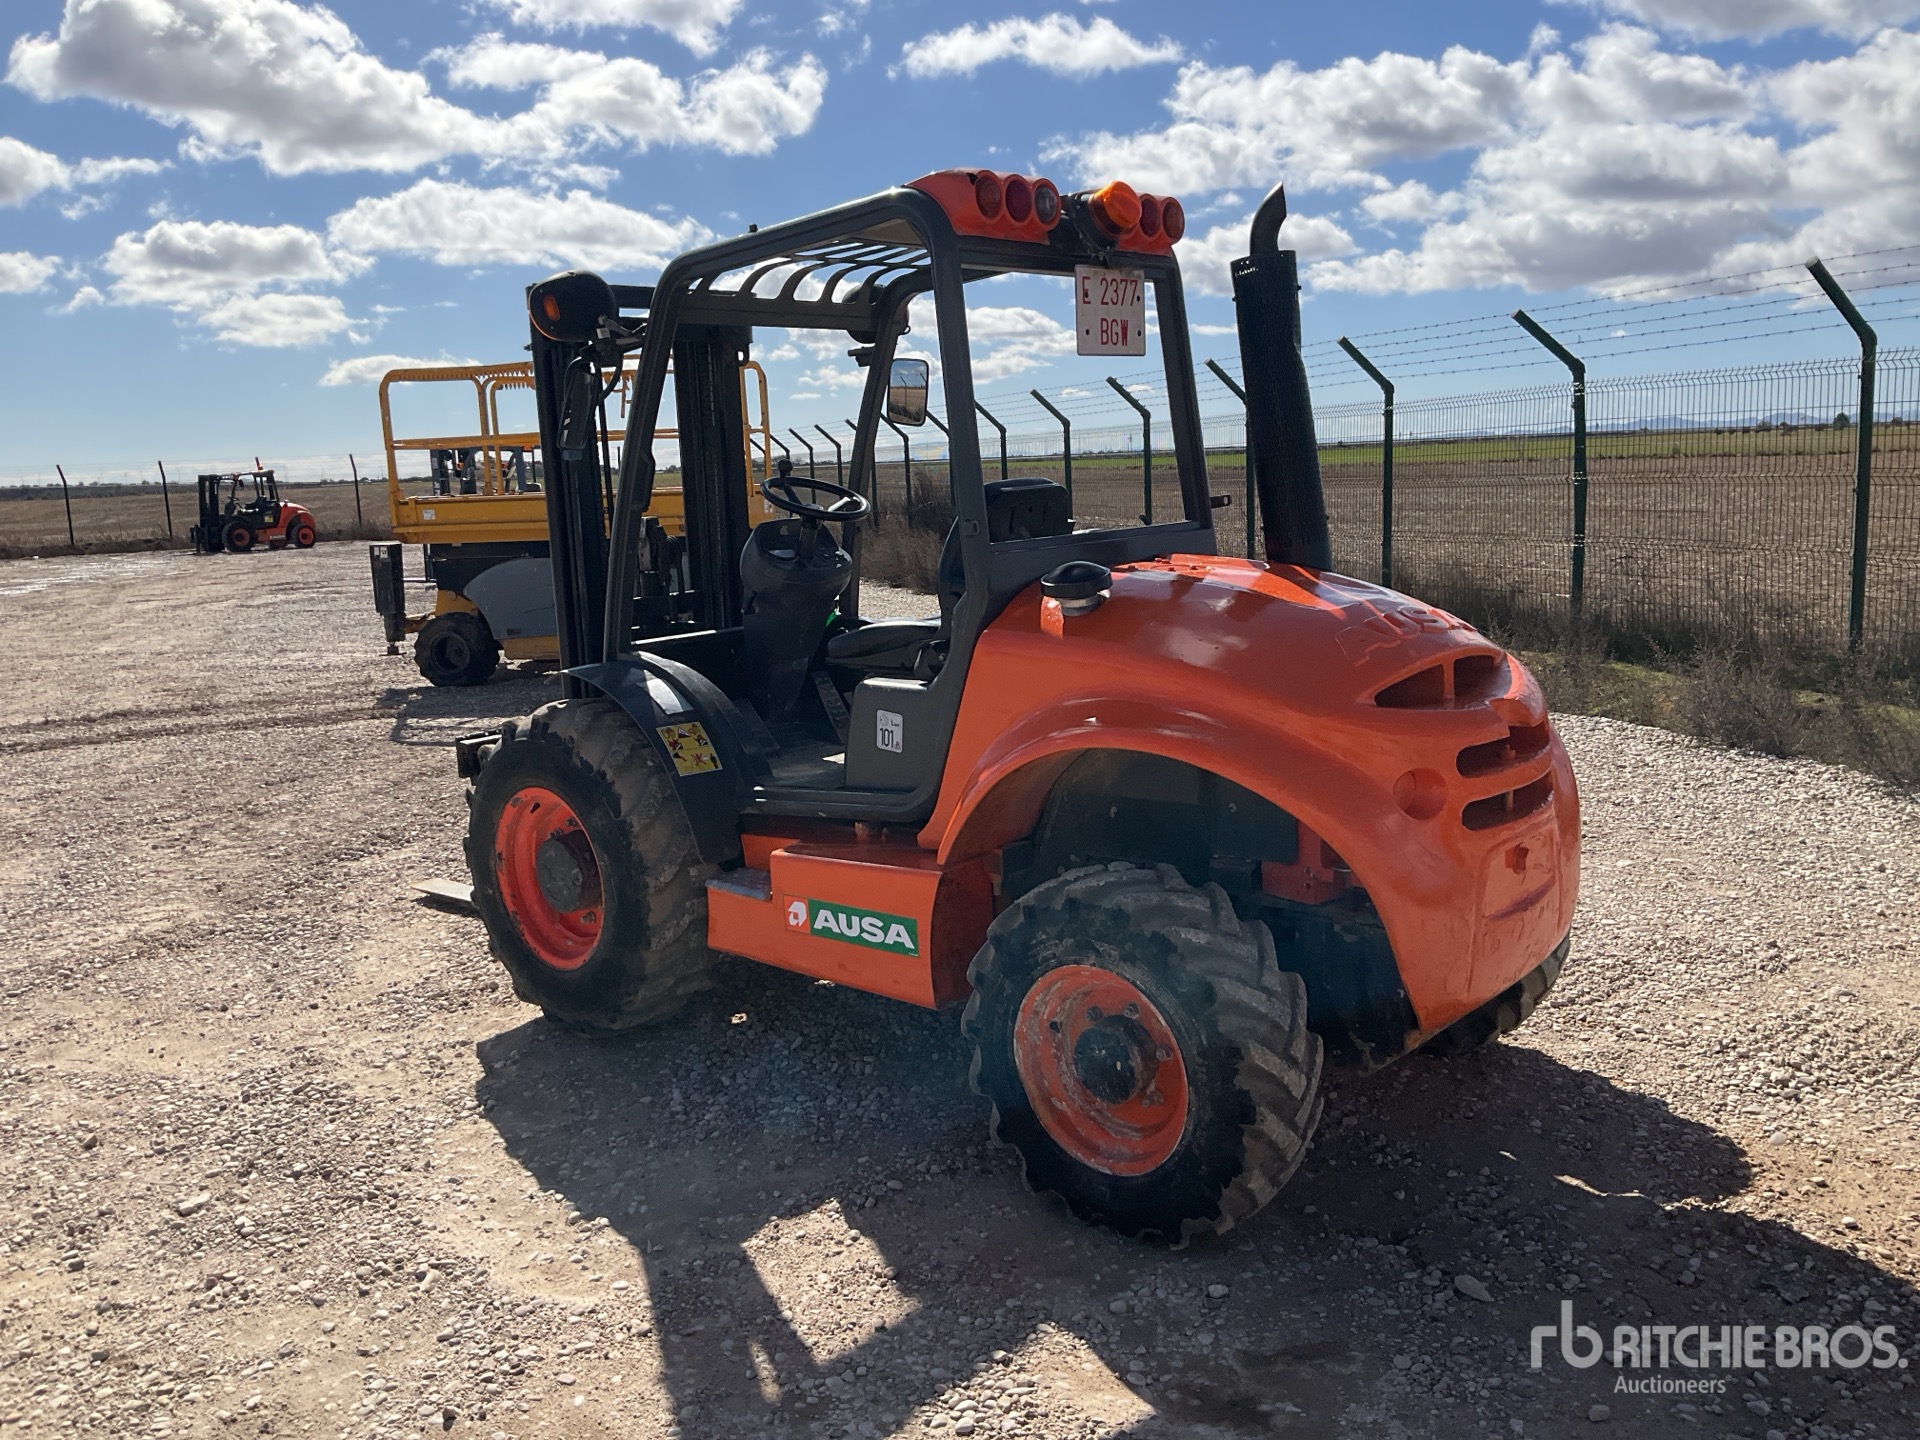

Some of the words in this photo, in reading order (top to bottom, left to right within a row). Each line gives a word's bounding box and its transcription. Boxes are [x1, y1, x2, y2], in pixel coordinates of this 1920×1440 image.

[1082, 276, 1091, 305] E
[1100, 277, 1138, 307] 2377
[1100, 317, 1129, 347] BGW
[879, 727, 894, 749] 101
[813, 909, 915, 949] AUSA
